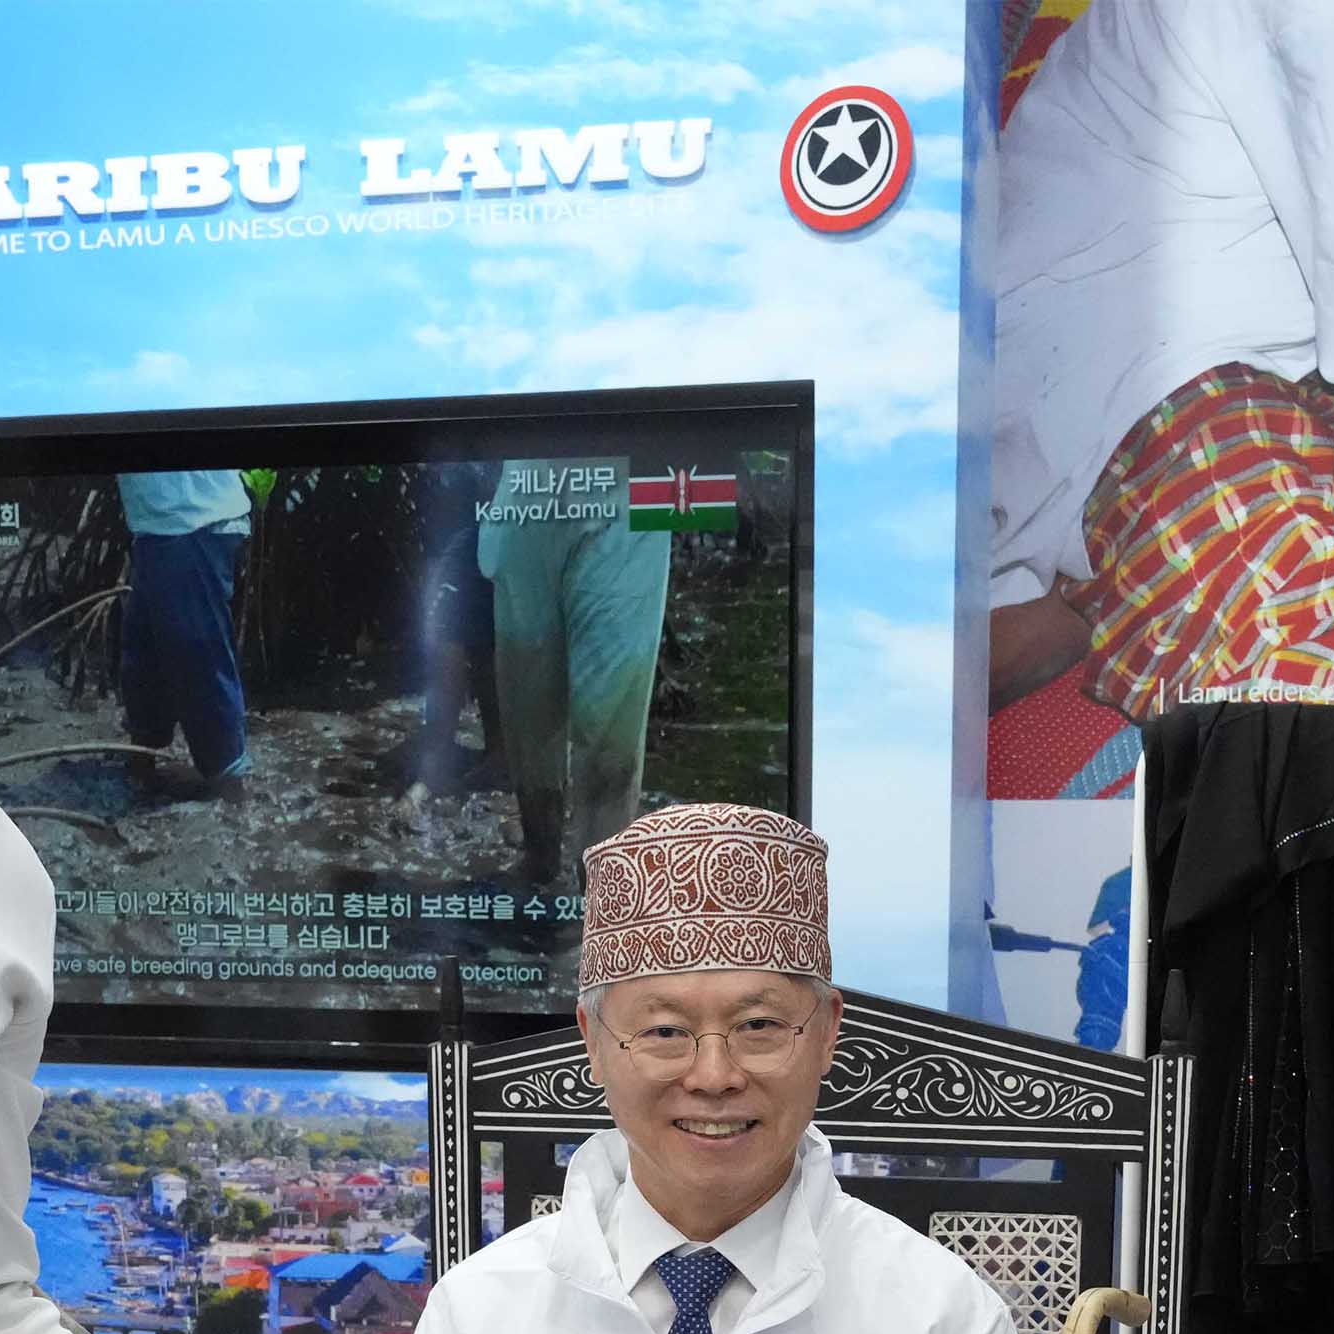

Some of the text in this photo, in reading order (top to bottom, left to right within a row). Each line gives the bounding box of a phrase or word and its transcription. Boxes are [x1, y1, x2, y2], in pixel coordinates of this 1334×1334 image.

[360, 118, 713, 197] LAMU
[30, 230, 71, 252] TO
[80, 223, 165, 250] LAMU
[174, 222, 195, 243] A
[204, 213, 330, 243] UNESCO
[337, 206, 455, 236] WORLD
[466, 197, 621, 226] HERITAGE
[509, 467, 616, 494] 케냐/라무
[475, 498, 616, 526] Kenya/Lamu
[1178, 682, 1242, 704] Lamu
[1248, 680, 1318, 703] elders
[55, 890, 139, 914] 고기들이
[146, 891, 236, 916] 안전하게
[244, 892, 335, 918] 번식하고
[343, 893, 411, 919] 충분히
[420, 894, 515, 920] 보호받을
[523, 896, 547, 921] 수
[177, 923, 390, 950] 맹그로브를 심습니다
[53, 955, 543, 983] ave safe breeding grounds and adequate otection
